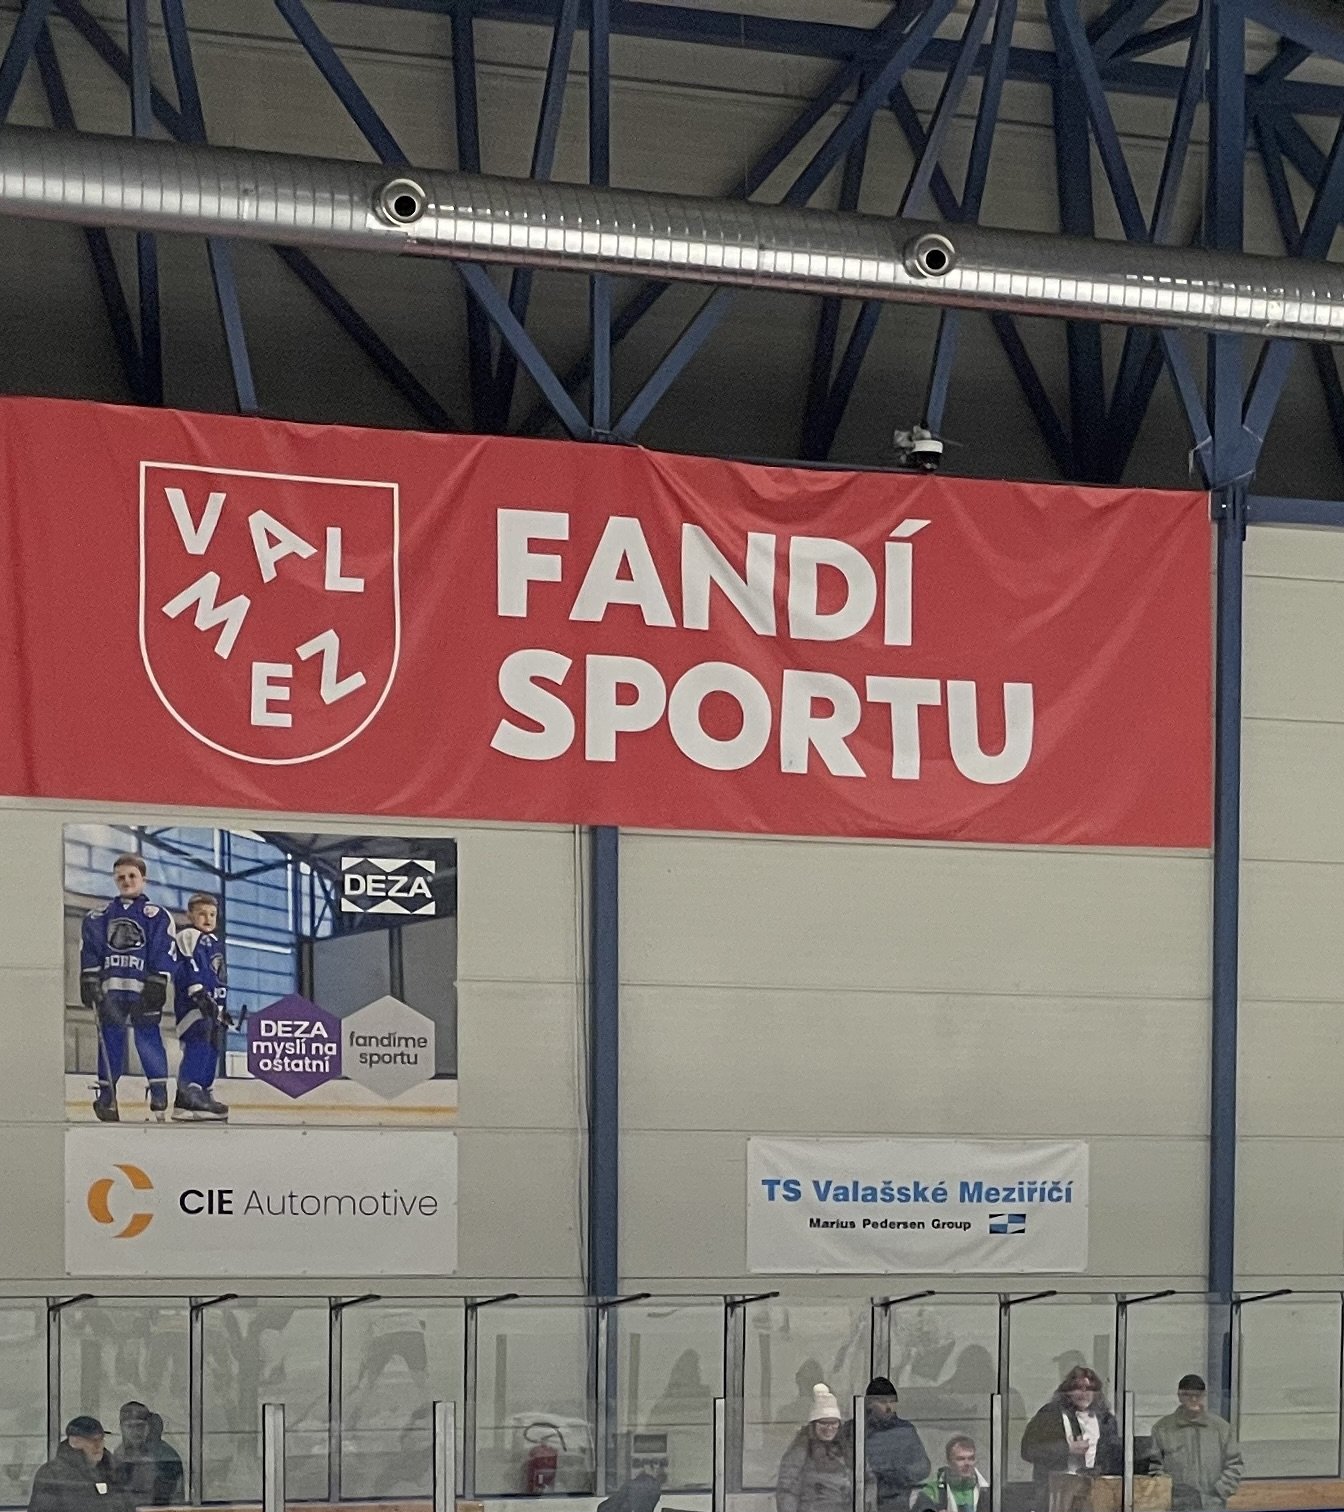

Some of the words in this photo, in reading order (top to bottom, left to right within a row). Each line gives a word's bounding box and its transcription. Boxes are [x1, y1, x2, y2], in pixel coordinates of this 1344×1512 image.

[496, 507, 932, 647] FANDÍ
[489, 648, 1035, 785] SPORTU
[344, 874, 433, 898] DEZA
[261, 1020, 328, 1038] DEZA
[253, 1037, 306, 1058] myslí
[312, 1042, 337, 1056] na
[350, 1031, 428, 1049] fandíme
[259, 1055, 330, 1073] ostatní
[359, 1050, 418, 1068] sportu
[761, 1179, 802, 1202] TS
[812, 1180, 948, 1204] Valašské
[959, 1180, 1074, 1204] Meziříčí
[179, 1188, 234, 1216] CIE
[243, 1188, 438, 1217] Automotive
[809, 1217, 856, 1230] Marius
[862, 1217, 926, 1230] Pedersen
[931, 1218, 972, 1232] Group
